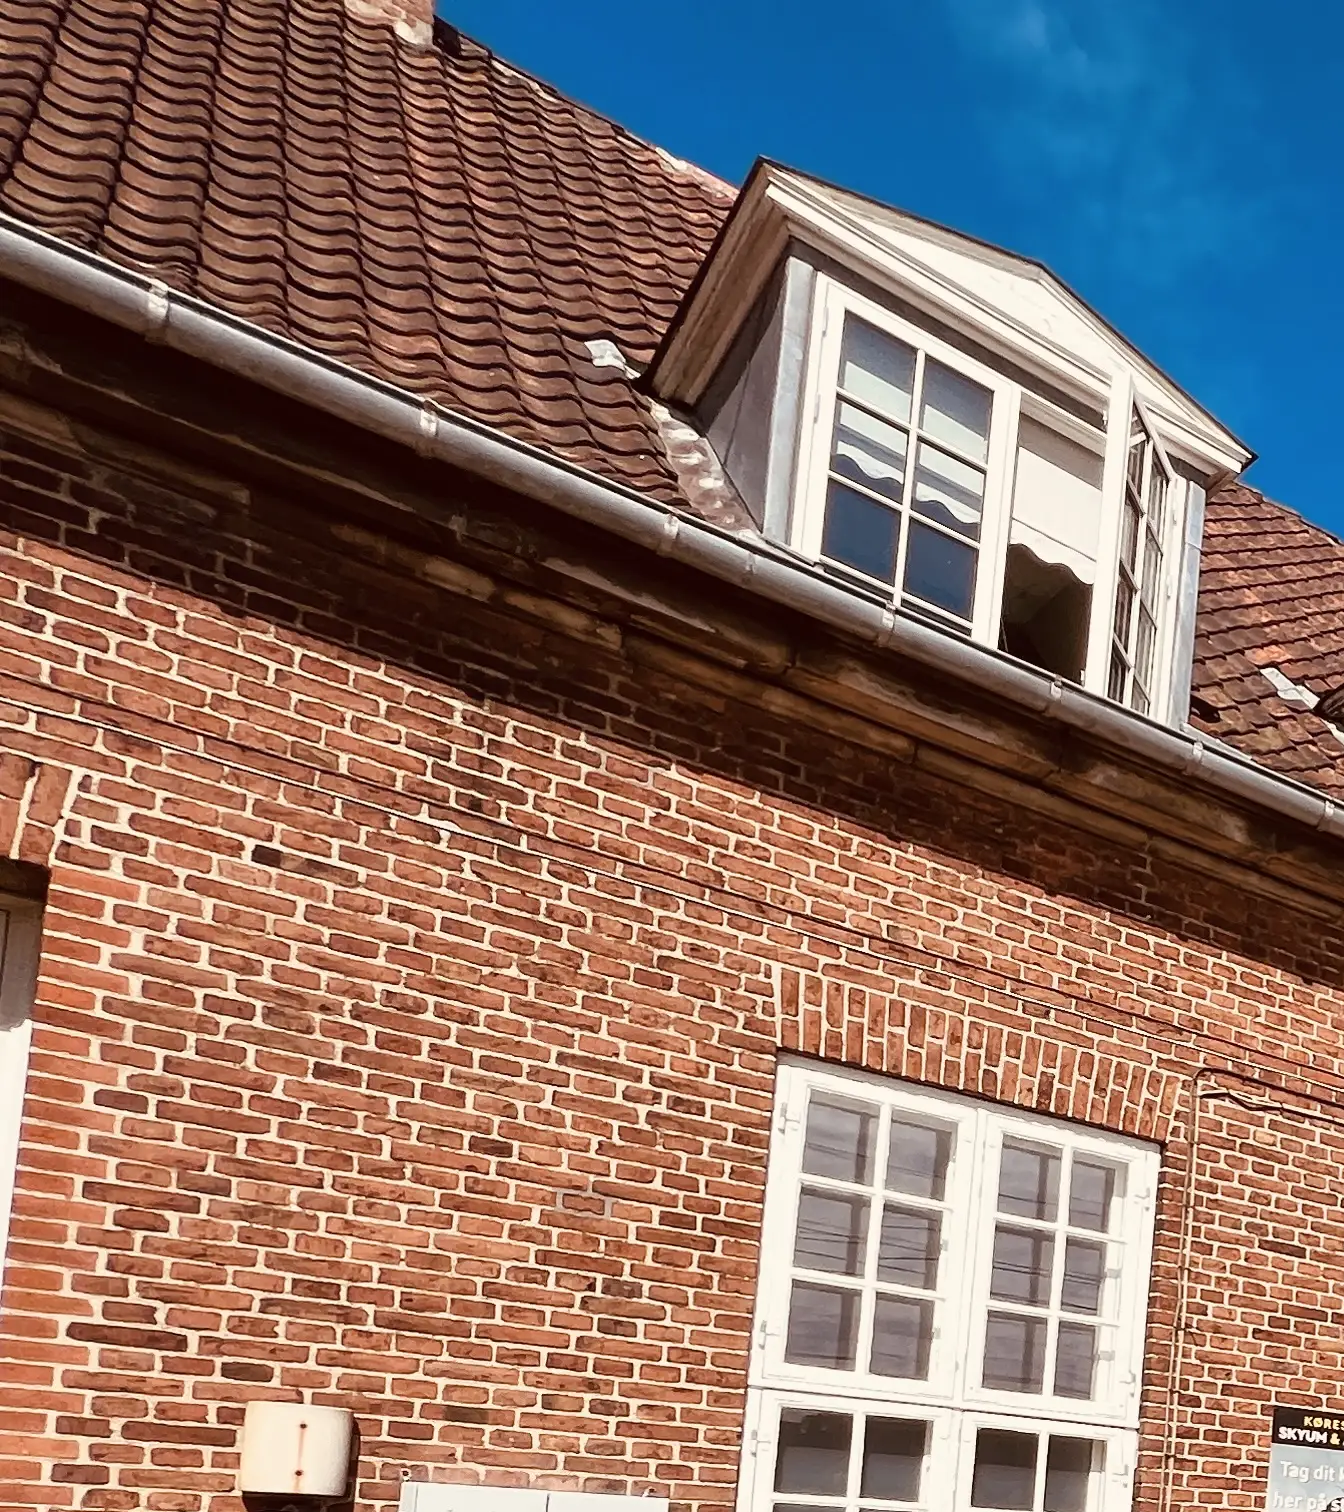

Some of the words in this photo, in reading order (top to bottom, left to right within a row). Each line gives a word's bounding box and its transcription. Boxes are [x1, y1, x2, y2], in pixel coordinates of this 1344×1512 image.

[1278, 1426, 1328, 1444] SKYUM
[1329, 1433, 1341, 1445] &
[1280, 1461, 1310, 1483] Tag
[1313, 1465, 1336, 1482] dit
[1272, 1491, 1302, 1509] her
[1307, 1492, 1327, 1512] på
